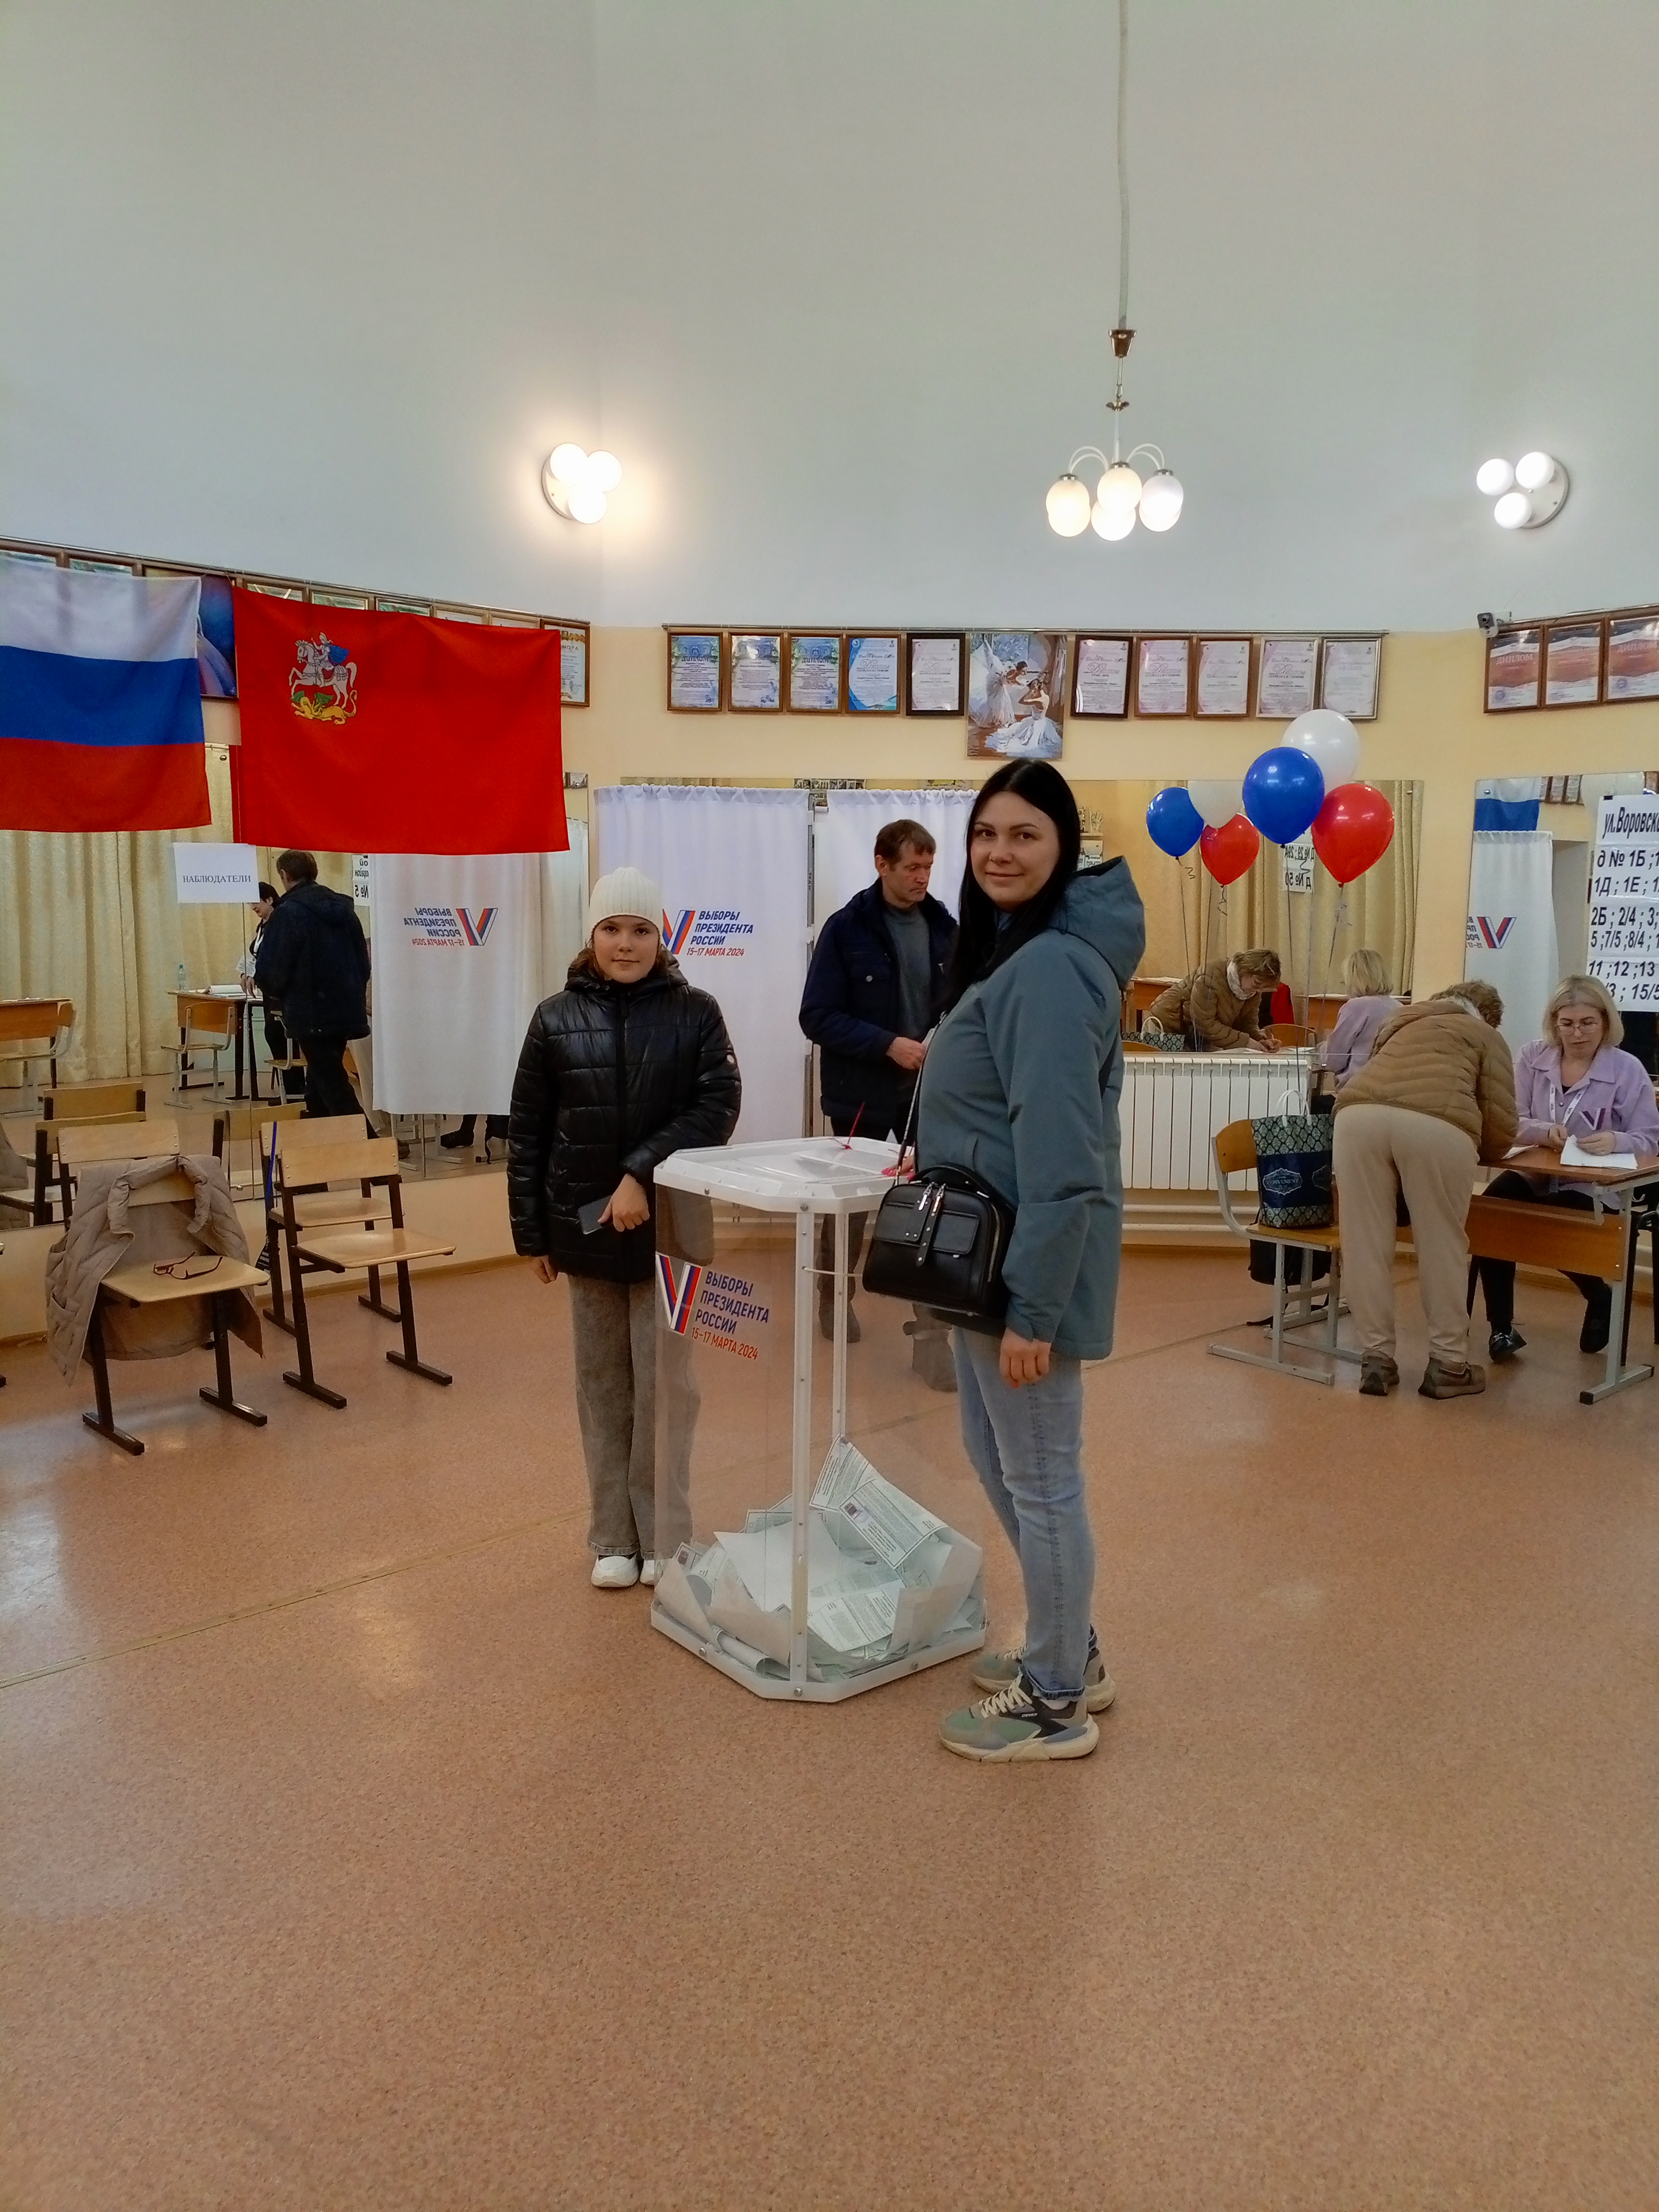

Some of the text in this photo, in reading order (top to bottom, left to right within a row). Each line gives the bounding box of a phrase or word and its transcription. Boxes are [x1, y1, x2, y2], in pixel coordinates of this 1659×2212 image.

[1609, 850, 1625, 867] №
[183, 875, 251, 884] НАБЛЮДАТЕЛИ
[698, 910, 741, 921] ВЫБОРЫ
[695, 923, 754, 934] ПРЕЗИДЕНТА
[690, 935, 726, 945] РОССИИ
[704, 947, 725, 956] МАРТА
[726, 948, 745, 957] 2024
[705, 1270, 754, 1297] ВЫБОРЫ
[700, 1289, 770, 1323] ПРЕЗИДЕНТА
[695, 1309, 737, 1335] РОССИИ
[711, 1334, 737, 1354] МАРТА
[737, 1343, 758, 1360] 2024
